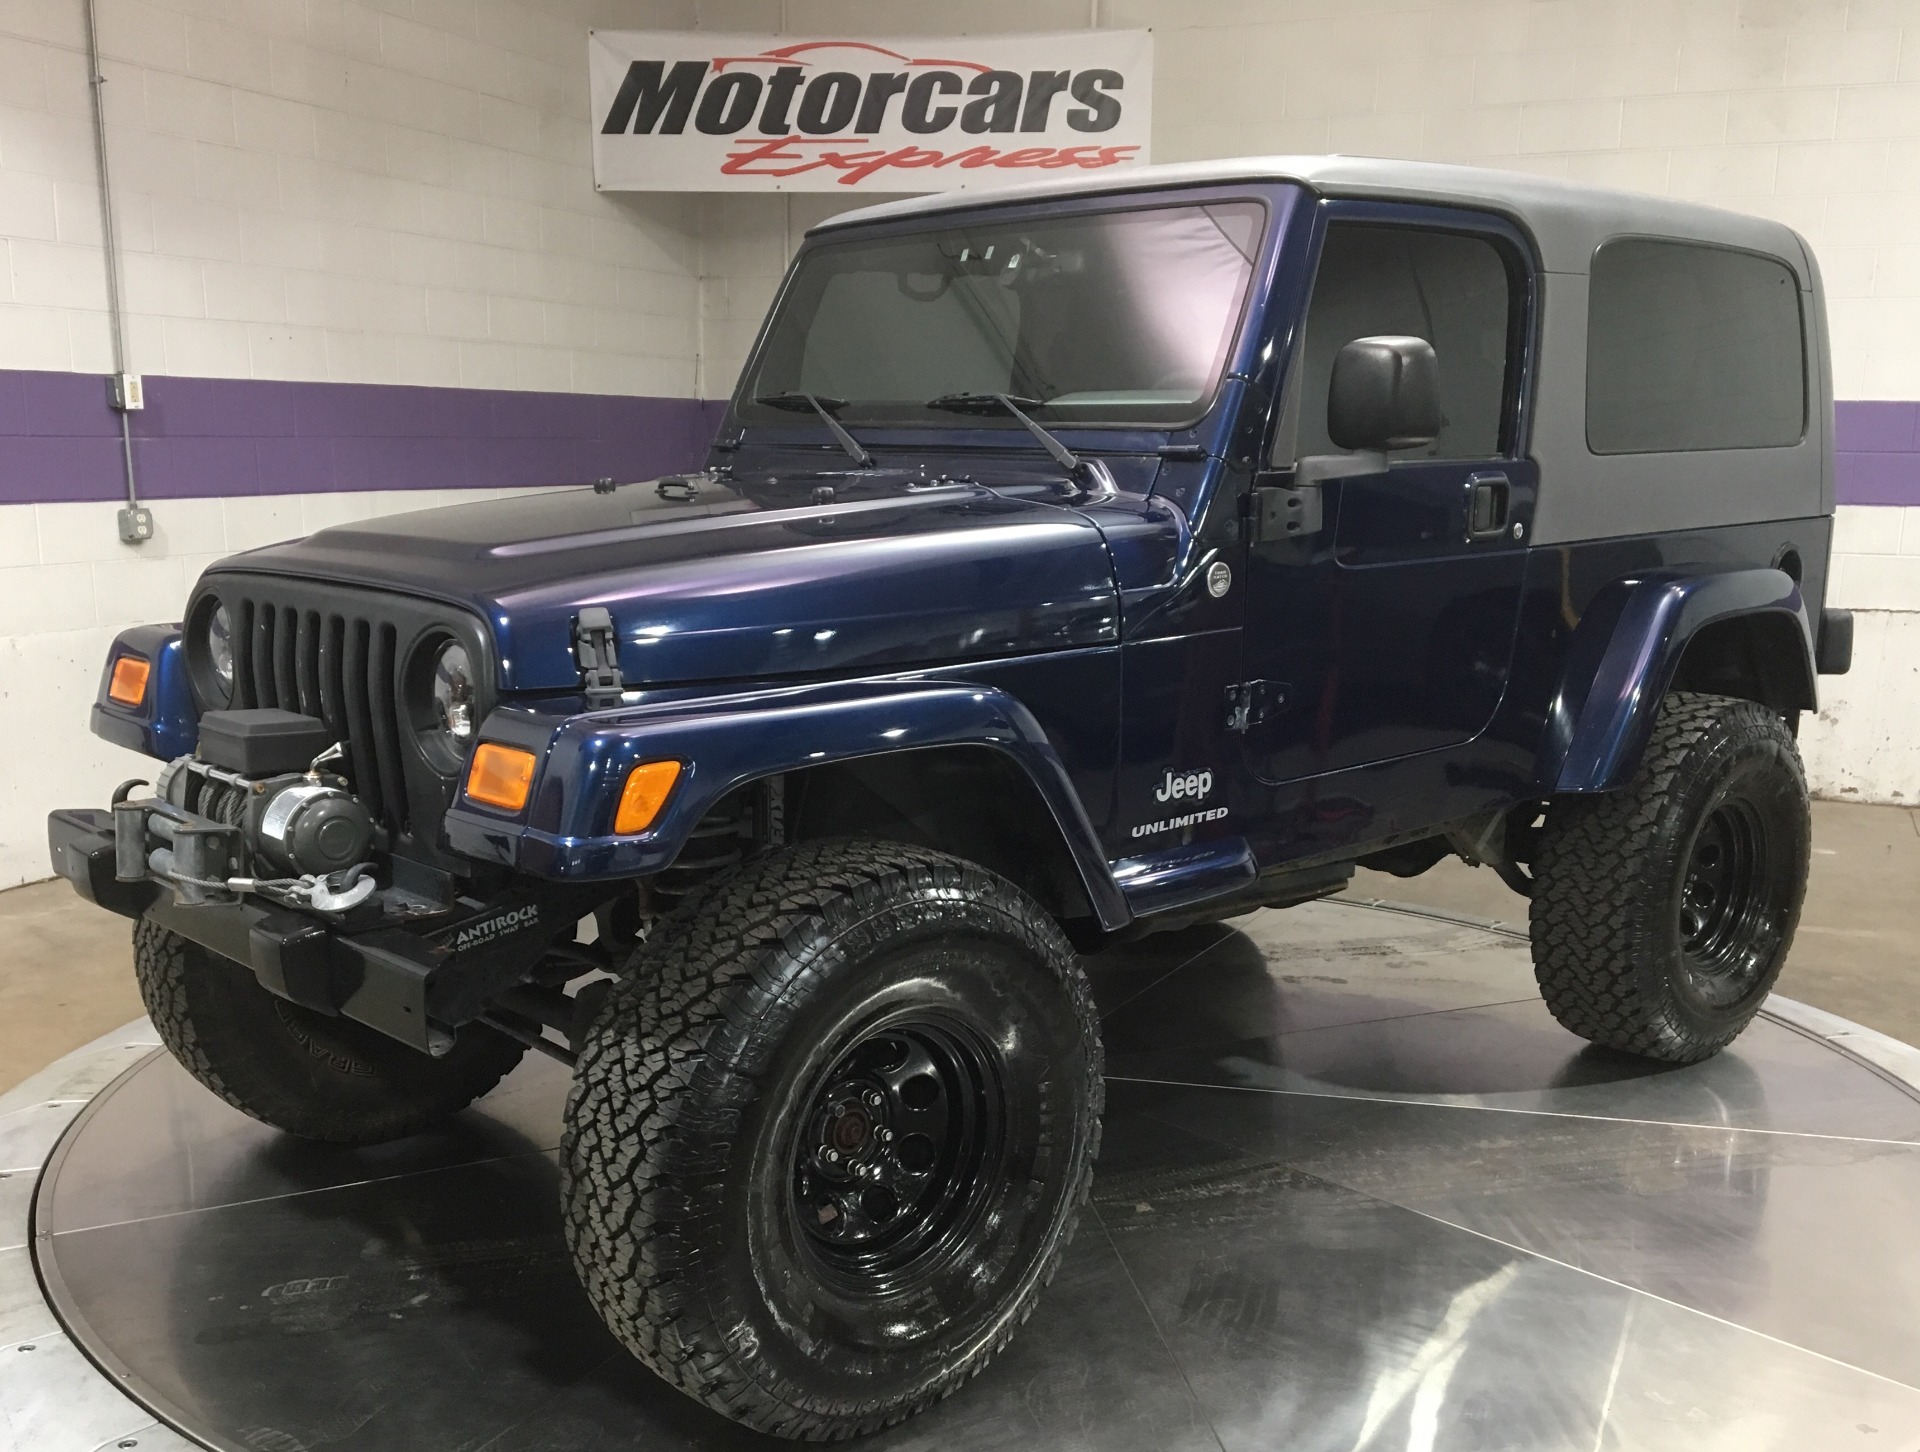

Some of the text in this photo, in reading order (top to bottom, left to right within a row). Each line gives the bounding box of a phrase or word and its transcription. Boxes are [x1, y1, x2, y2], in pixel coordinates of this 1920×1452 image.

[600, 60, 1125, 136] Motorcars
[720, 135, 1142, 186] Express
[1156, 771, 1212, 802] Jeep
[1132, 807, 1229, 838] UNLIMITED
[457, 904, 539, 945] ANTIROCK
[458, 933, 496, 952] OFF-ROAD
